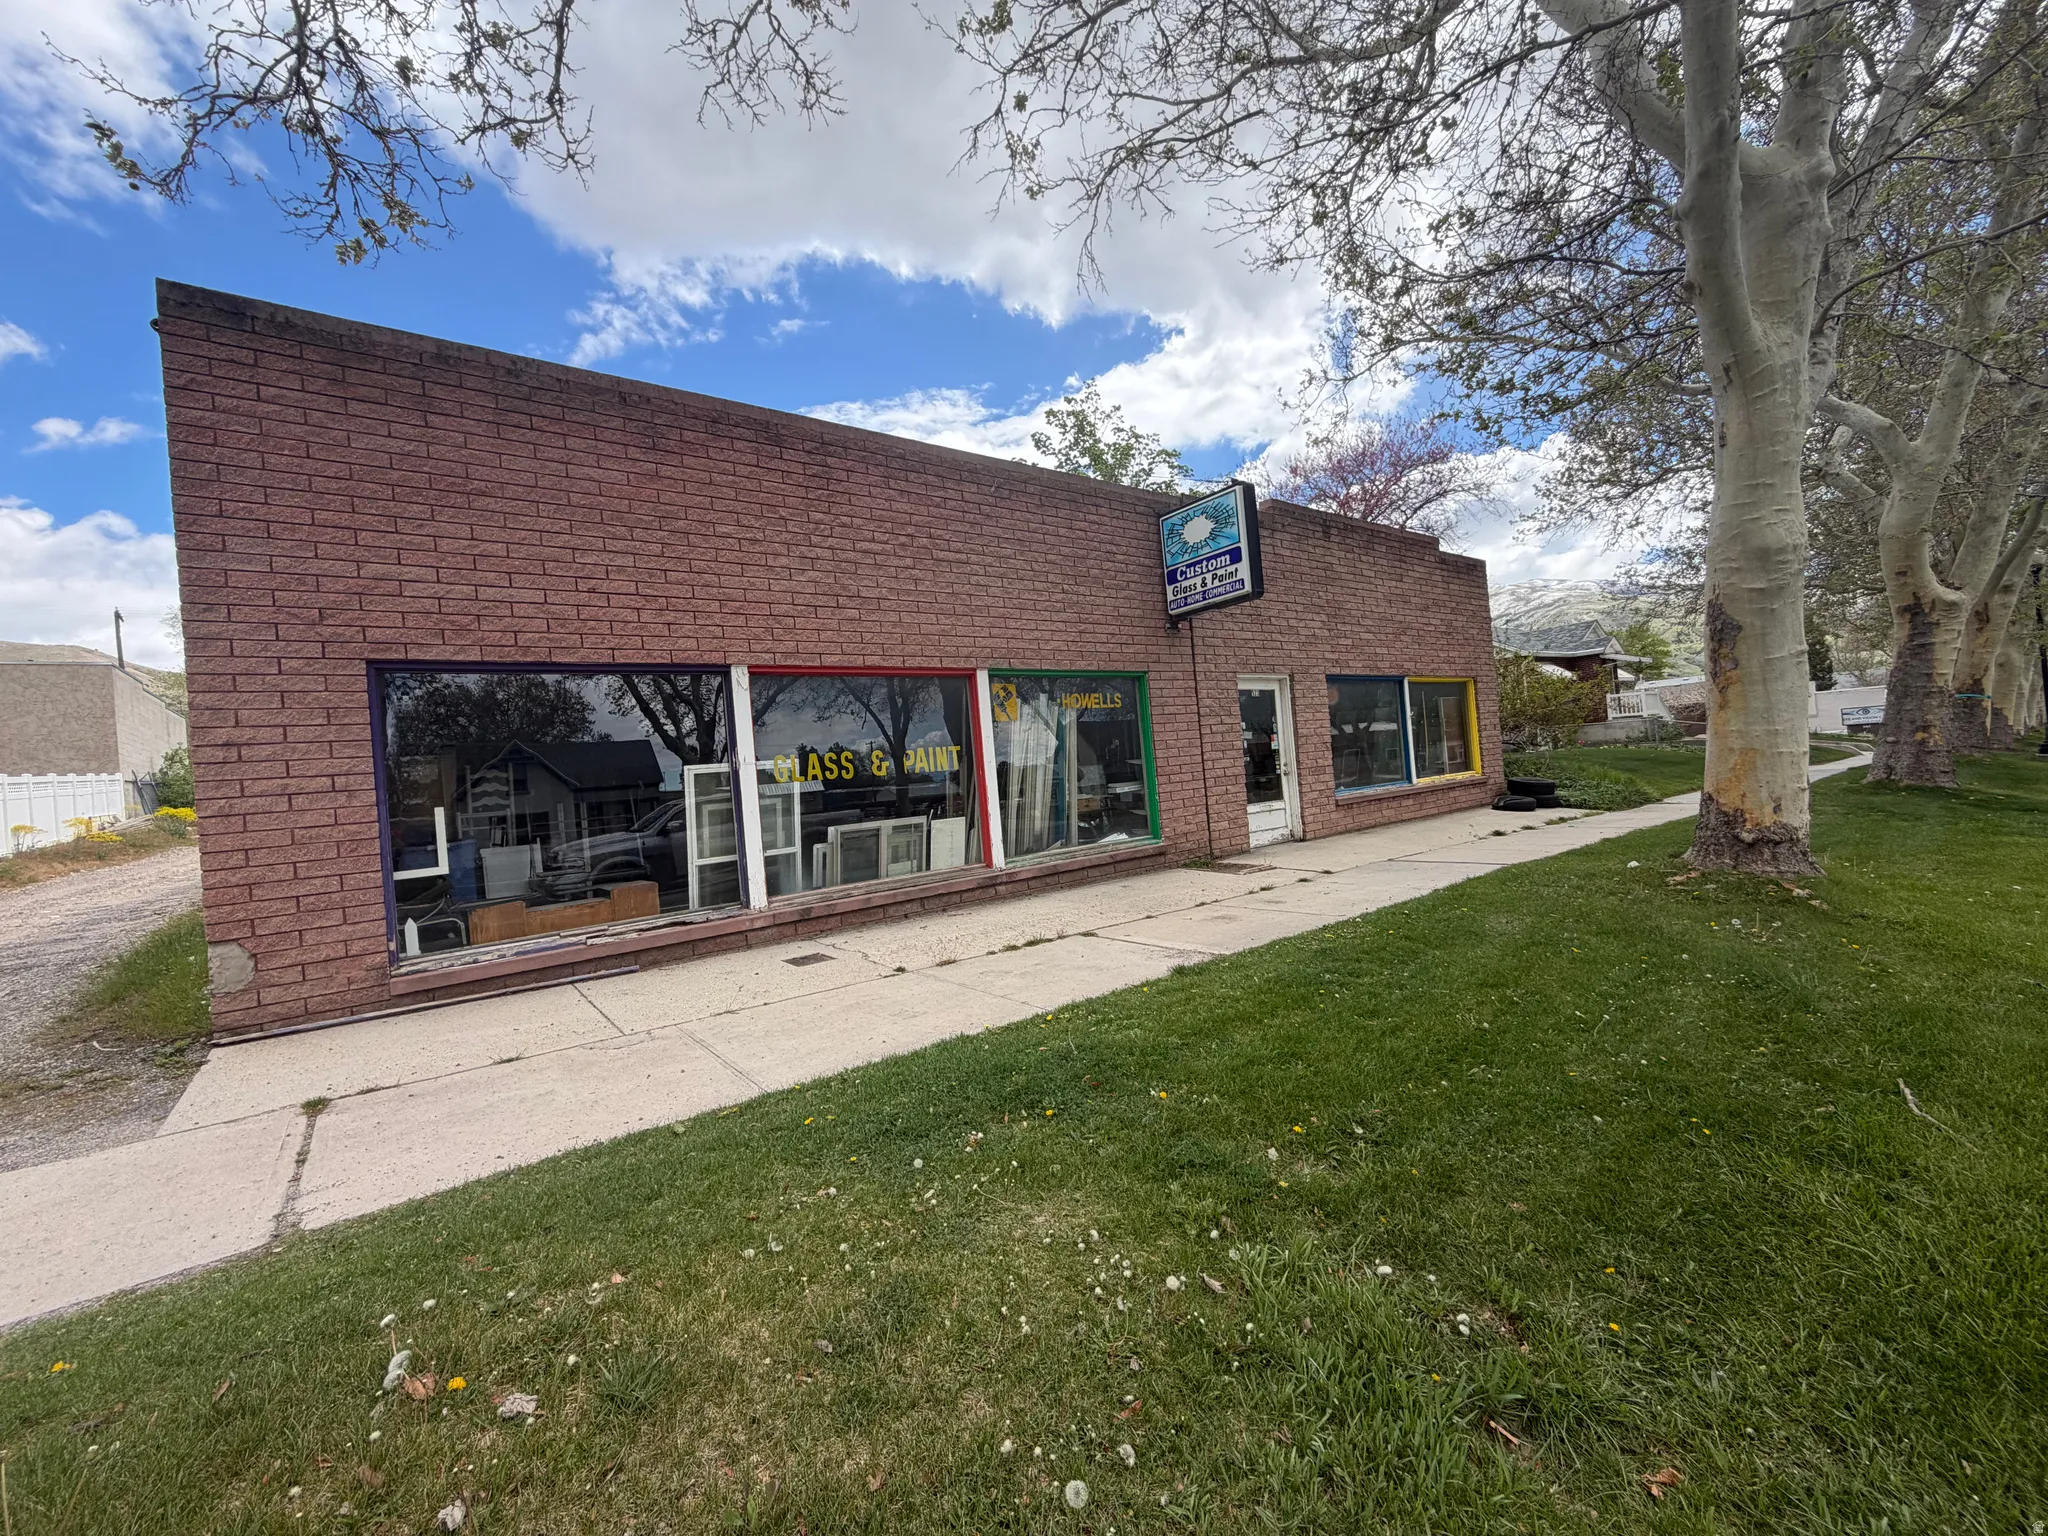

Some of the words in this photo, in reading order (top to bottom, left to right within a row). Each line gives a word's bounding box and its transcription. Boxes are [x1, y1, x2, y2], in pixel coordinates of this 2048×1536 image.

[1176, 554, 1231, 581] Custom
[1172, 582, 1197, 597] Glass
[1200, 576, 1208, 588] &
[1211, 567, 1239, 585] Paint
[1061, 692, 1123, 709] HOWELLS
[773, 750, 855, 783] GLASS
[870, 749, 890, 777] &
[903, 745, 961, 775] PAINT
